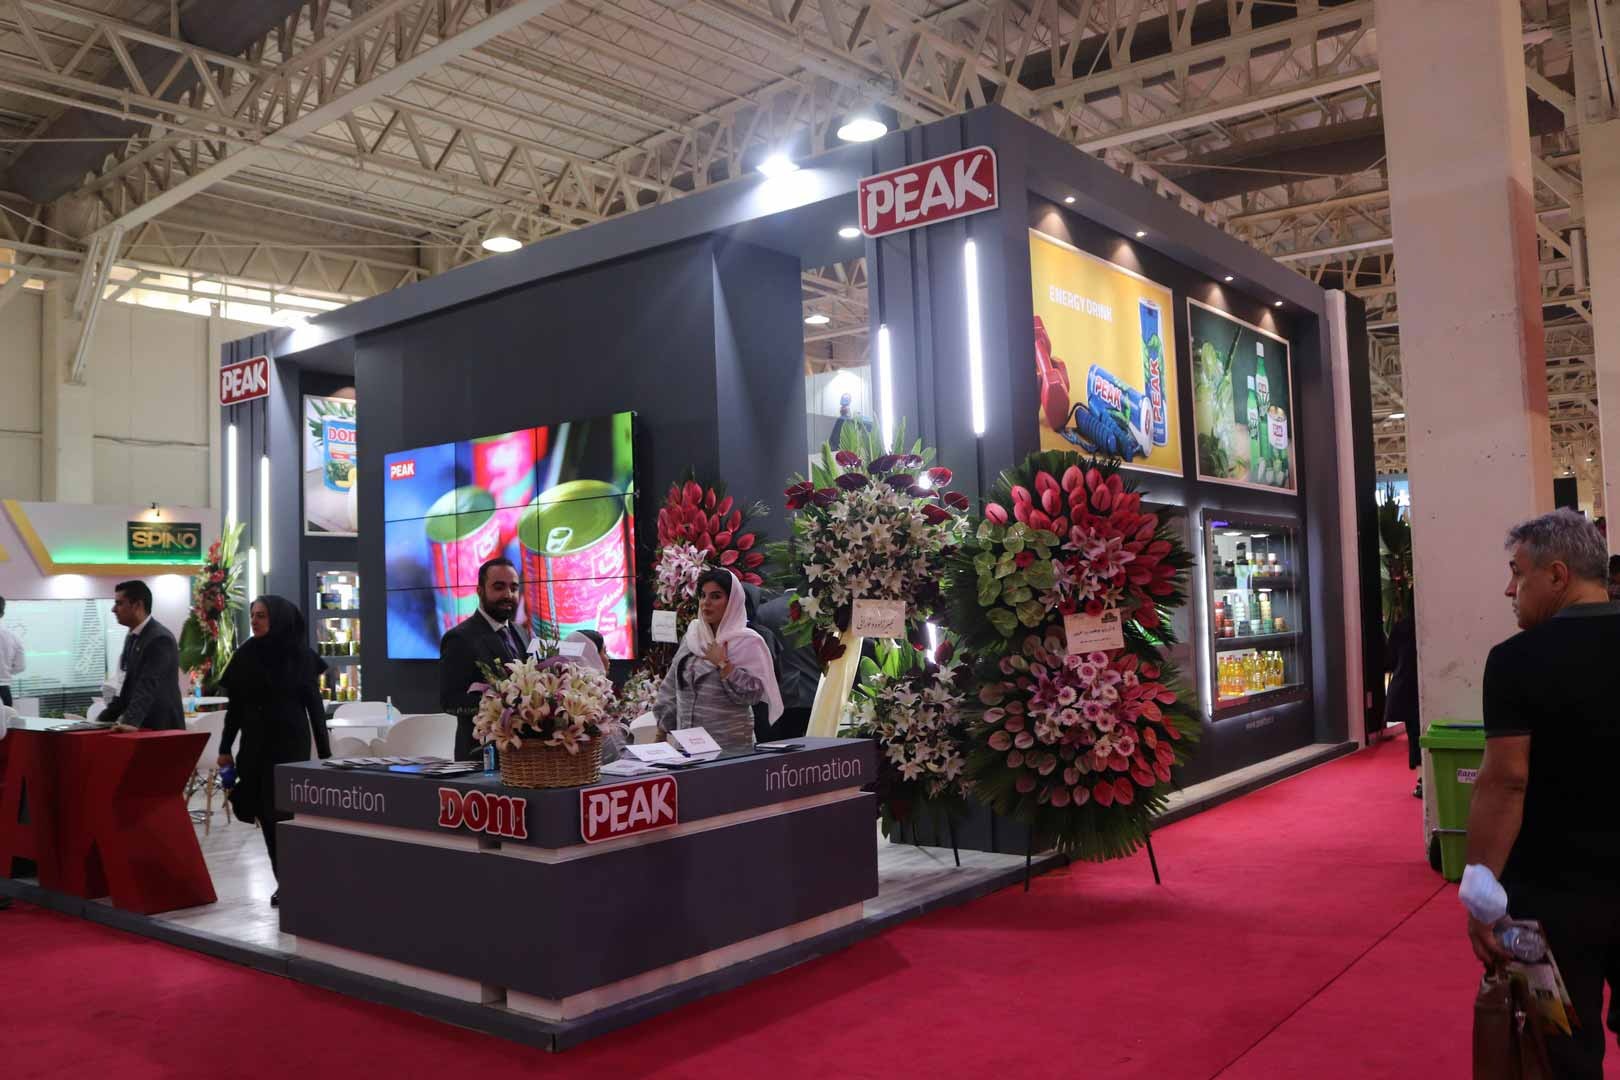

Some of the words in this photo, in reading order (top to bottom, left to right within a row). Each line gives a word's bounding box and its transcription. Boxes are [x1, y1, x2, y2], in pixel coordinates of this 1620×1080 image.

[866, 154, 989, 231] PEAK
[1049, 285, 1086, 312] ENERGY
[1087, 299, 1112, 322] DRINK
[222, 361, 266, 401] PEAK
[1094, 375, 1122, 411] PEAK
[1150, 357, 1162, 424] PEAK
[390, 463, 415, 479] PEAK
[132, 531, 197, 549] SPINO
[765, 757, 861, 792] information
[290, 778, 385, 813] information
[588, 782, 674, 838] PEAK
